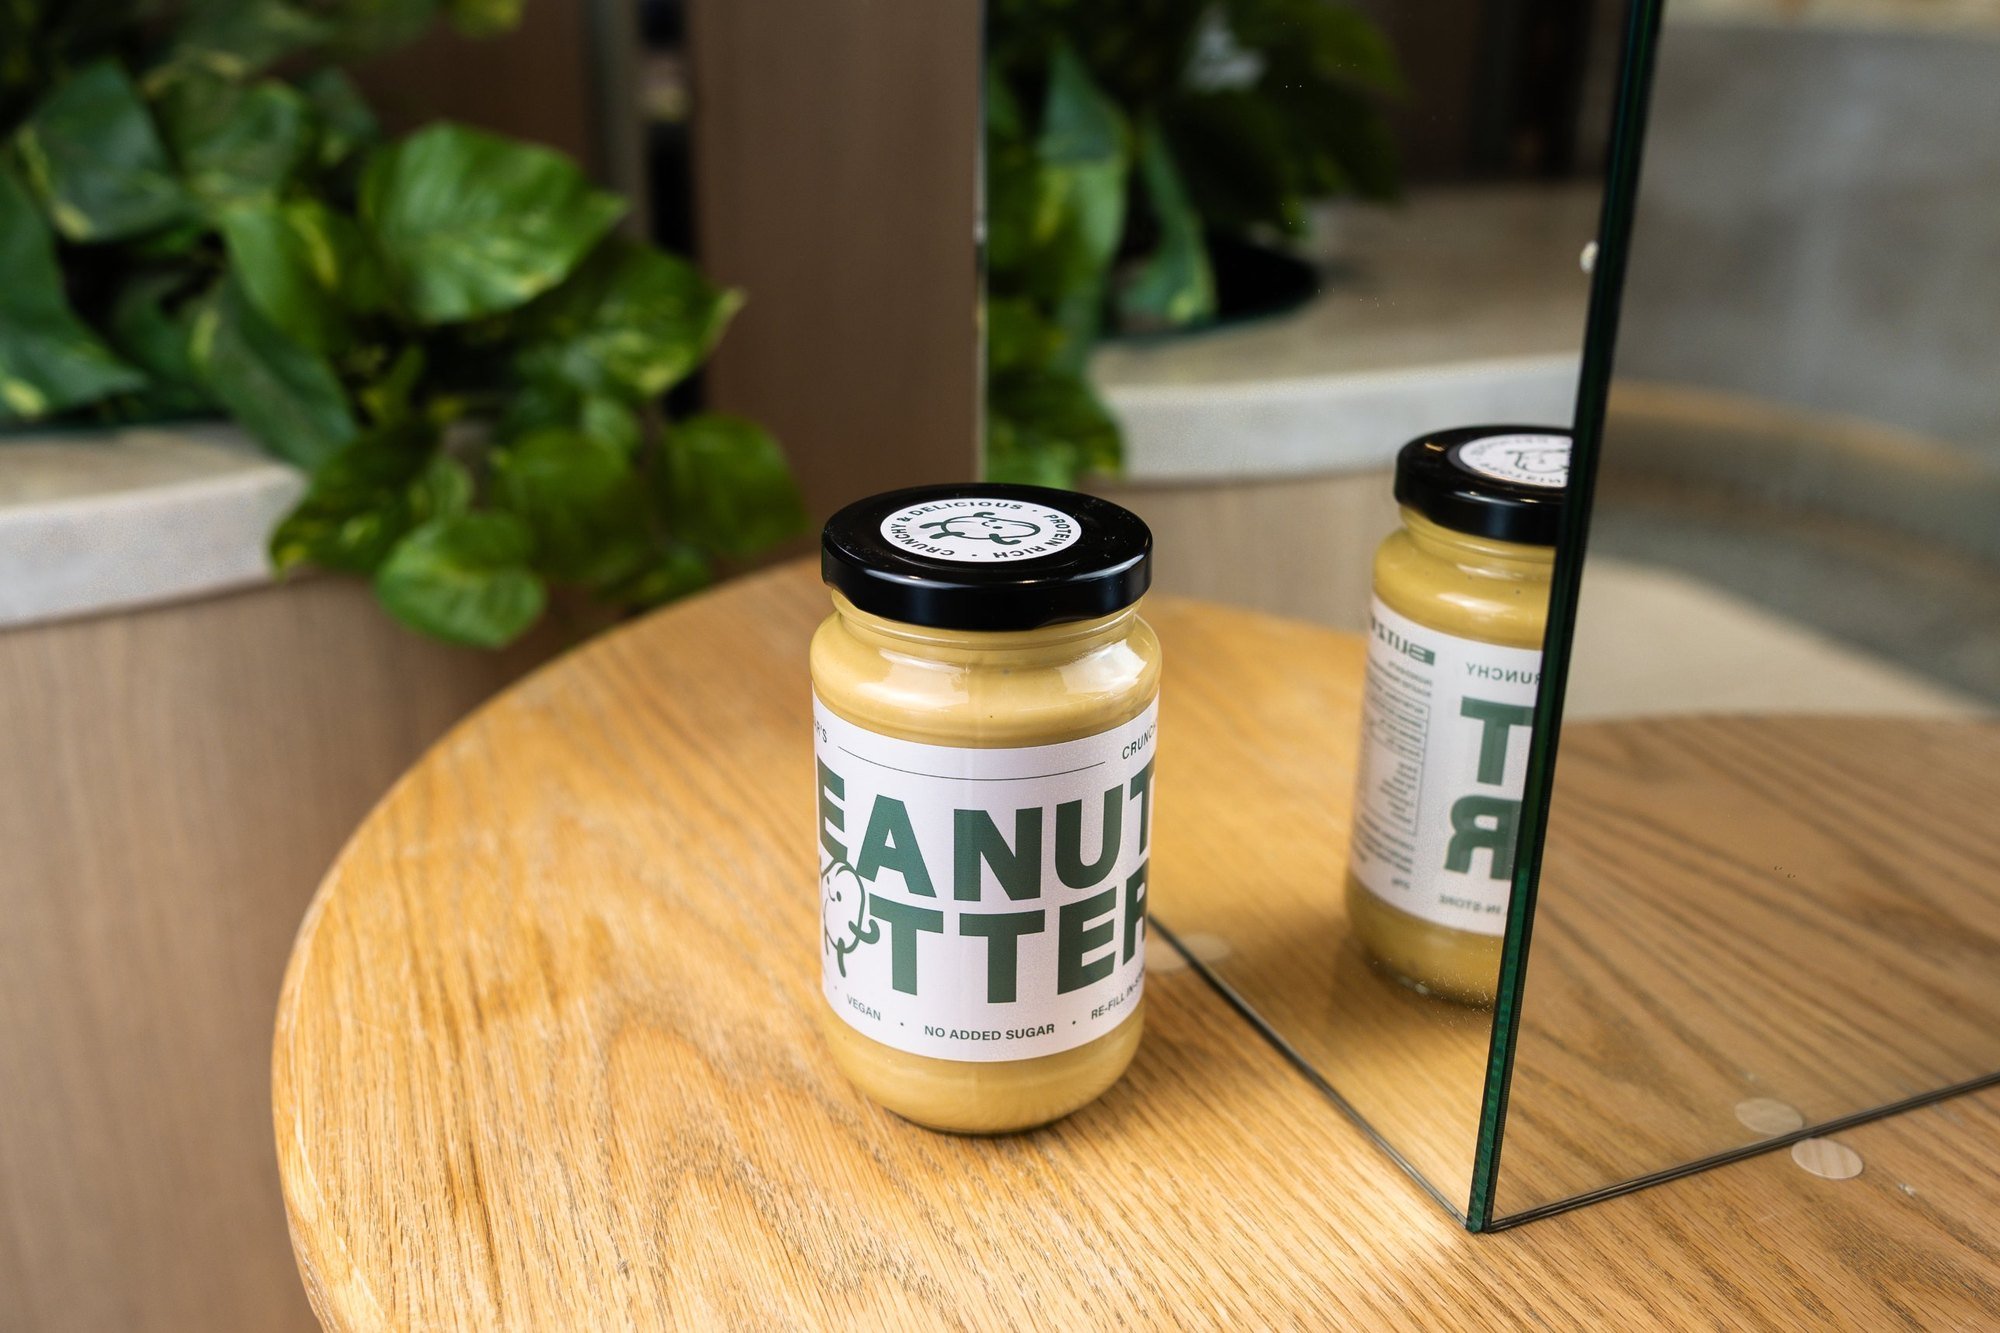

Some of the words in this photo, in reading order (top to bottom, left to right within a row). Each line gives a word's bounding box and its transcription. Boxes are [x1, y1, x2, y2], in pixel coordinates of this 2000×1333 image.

[897, 514, 913, 522] &
[909, 501, 1024, 517] DELICIOUS
[890, 523, 955, 557] CRUNCHY
[1043, 514, 1072, 547] PROTEIN
[993, 545, 1048, 559] RICH
[846, 993, 881, 1021] VEGAN
[924, 1025, 946, 1038] NO
[949, 1029, 1001, 1041] ADDED
[1005, 1023, 1055, 1040] SUGAR
[1091, 992, 1124, 1020] RE-FILL
